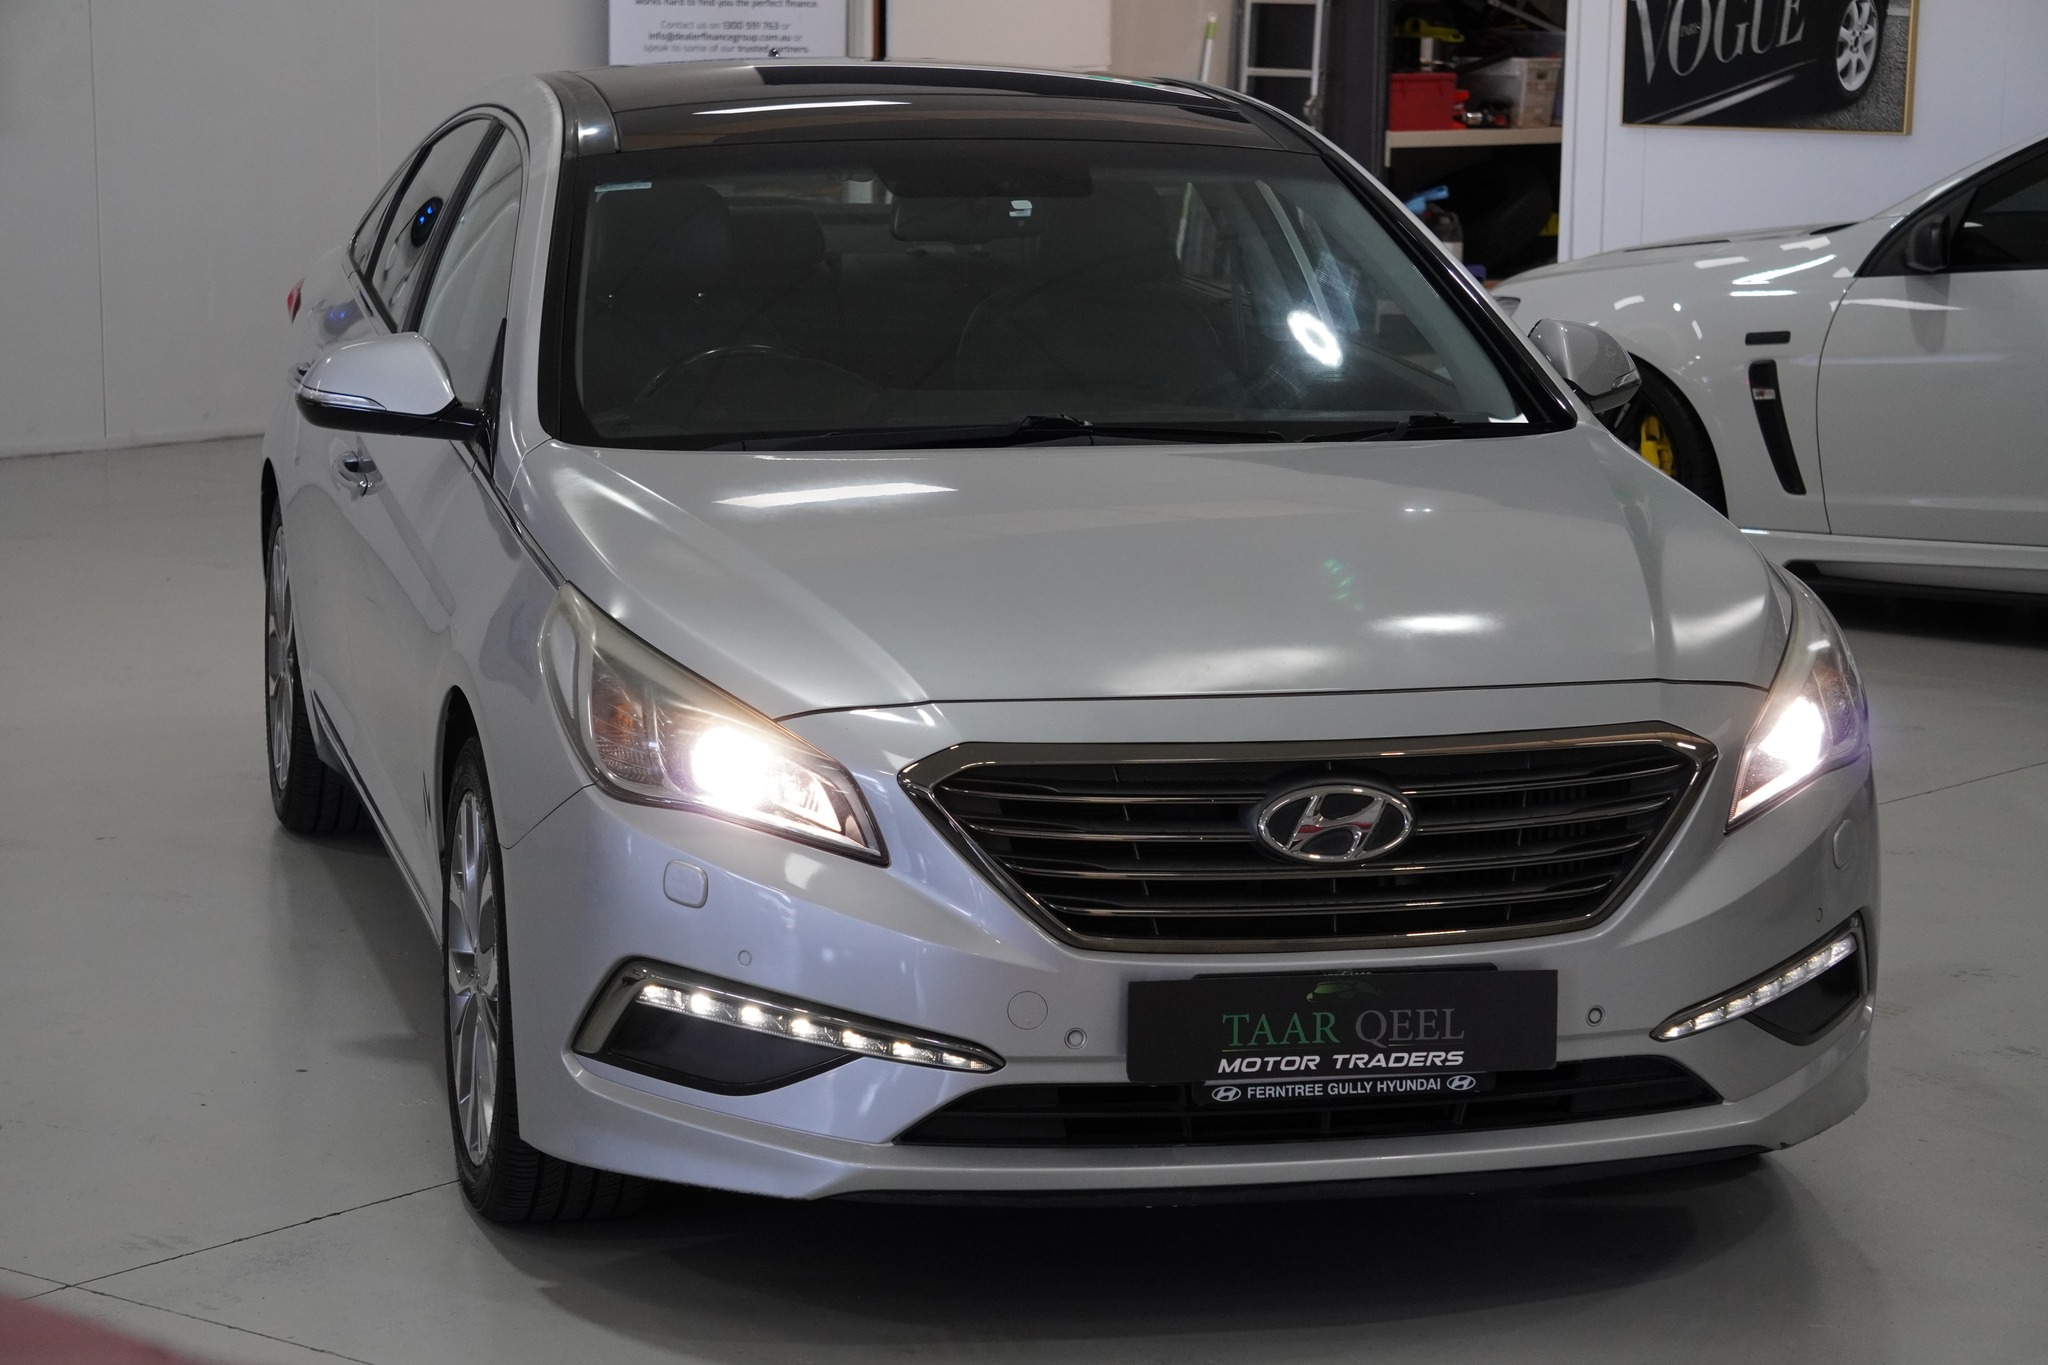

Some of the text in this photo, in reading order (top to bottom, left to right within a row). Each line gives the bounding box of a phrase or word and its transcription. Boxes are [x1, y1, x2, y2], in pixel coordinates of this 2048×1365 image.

[717, 0, 735, 8] you
[751, 0, 783, 9] perfect
[660, 20, 695, 30] Contact
[696, 22, 708, 30] us
[709, 22, 721, 30] on
[780, 23, 792, 31] or
[647, 31, 803, 43] info@dealerfinancegroup.com.au or
[1629, 0, 1806, 85] VOGUE
[643, 44, 669, 53] speak
[671, 44, 681, 52] to
[709, 44, 719, 52] of
[720, 45, 735, 53] our
[736, 45, 769, 53] trusted
[1222, 1008, 1465, 1049] TAAR QEEL
[1217, 1050, 1465, 1074] MOTOR TRADERS
[1247, 1078, 1441, 1099] FERNTREE GULLY HYUNDAI
